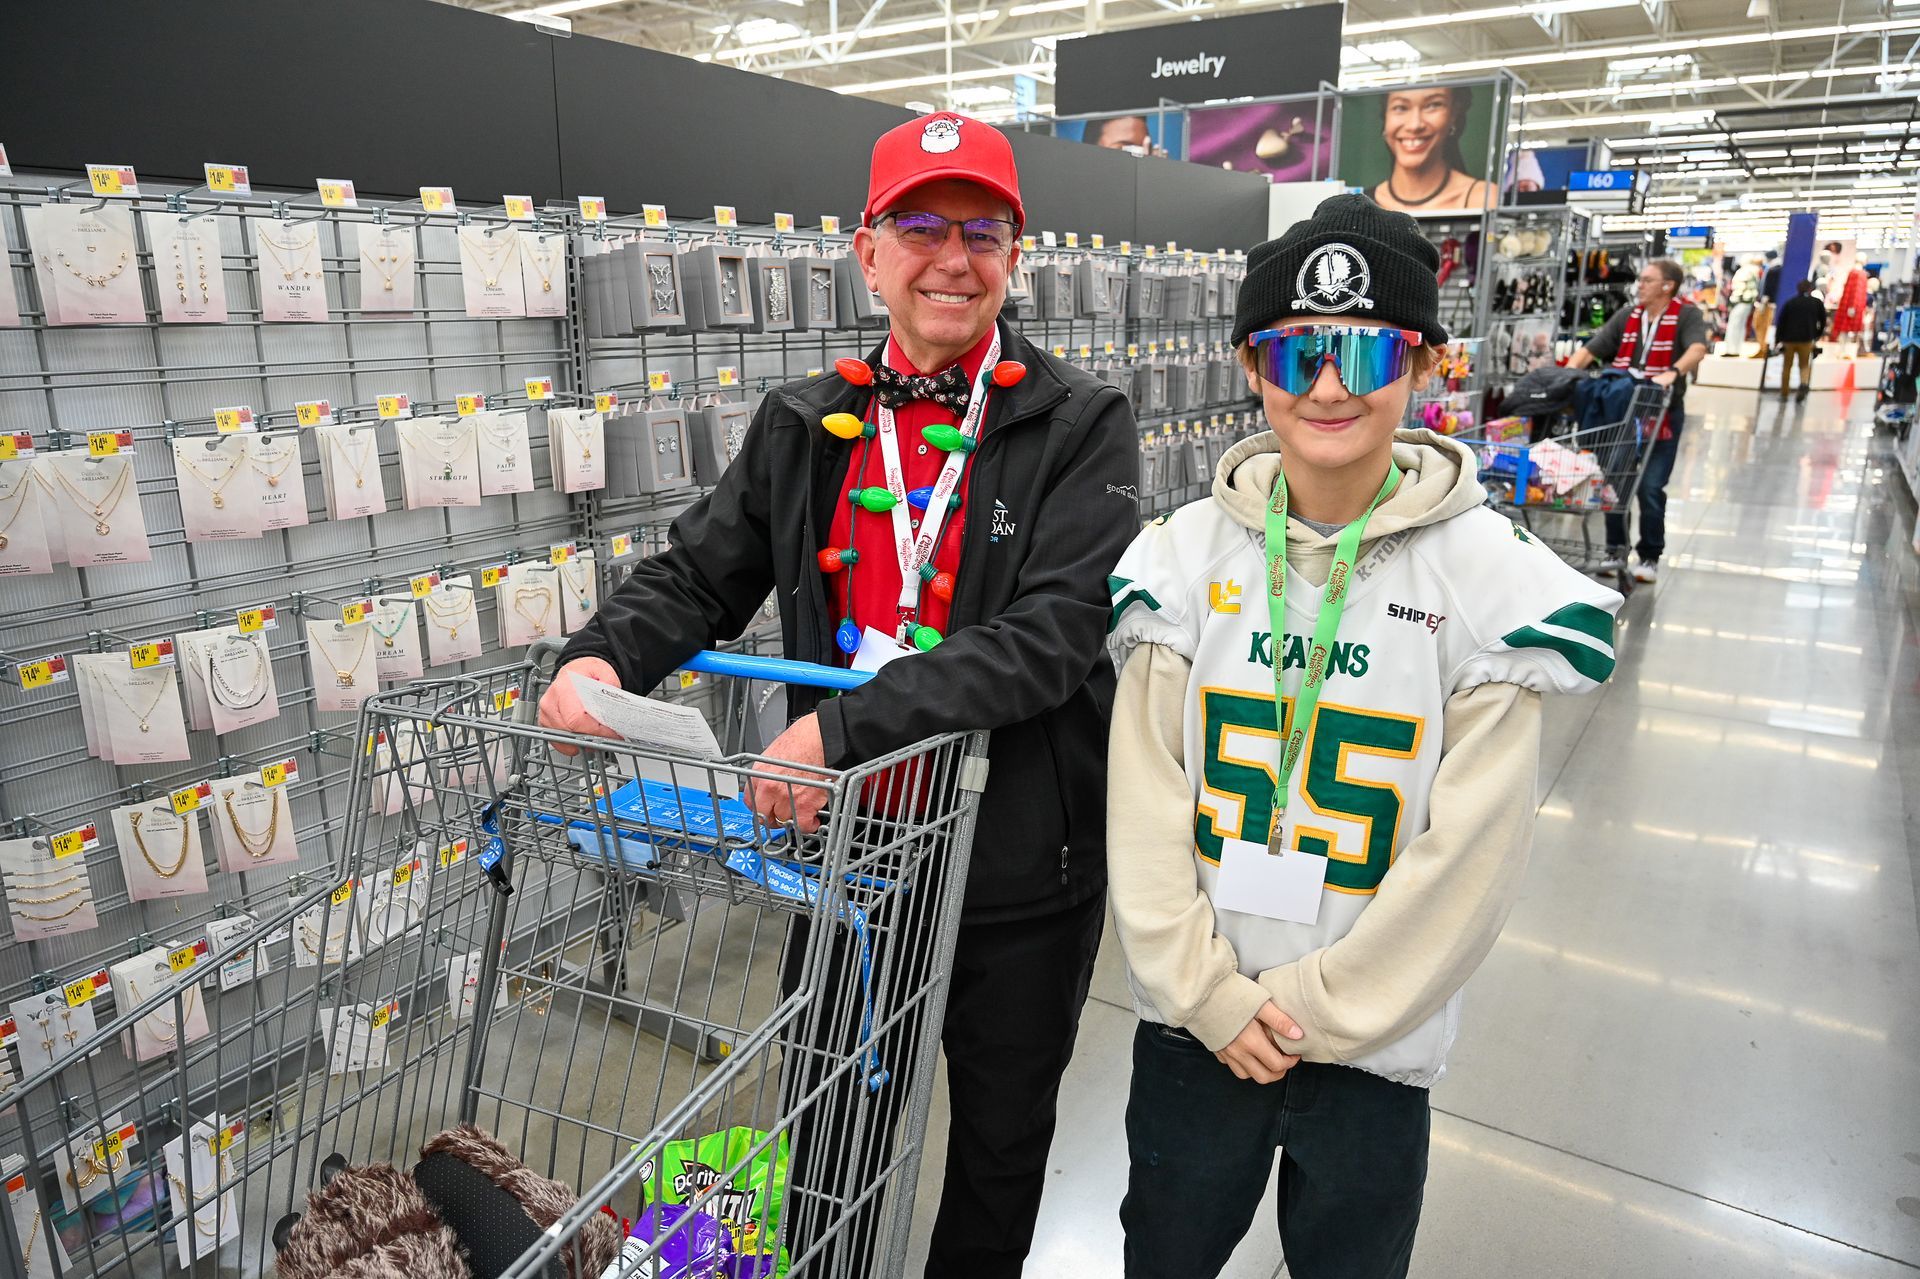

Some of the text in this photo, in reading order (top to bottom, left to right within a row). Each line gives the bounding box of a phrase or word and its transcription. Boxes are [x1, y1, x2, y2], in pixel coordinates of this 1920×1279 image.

[1151, 52, 1226, 79] Jewelry
[1587, 172, 1614, 188] 160
[262, 493, 287, 501] HEART
[376, 649, 404, 657] DREAM
[1248, 632, 1370, 680] KANS
[1196, 687, 1425, 895] 55
[768, 864, 795, 882] Please:
[768, 877, 778, 887] use
[780, 882, 797, 894] seat
[675, 1170, 733, 1194] Dorits
